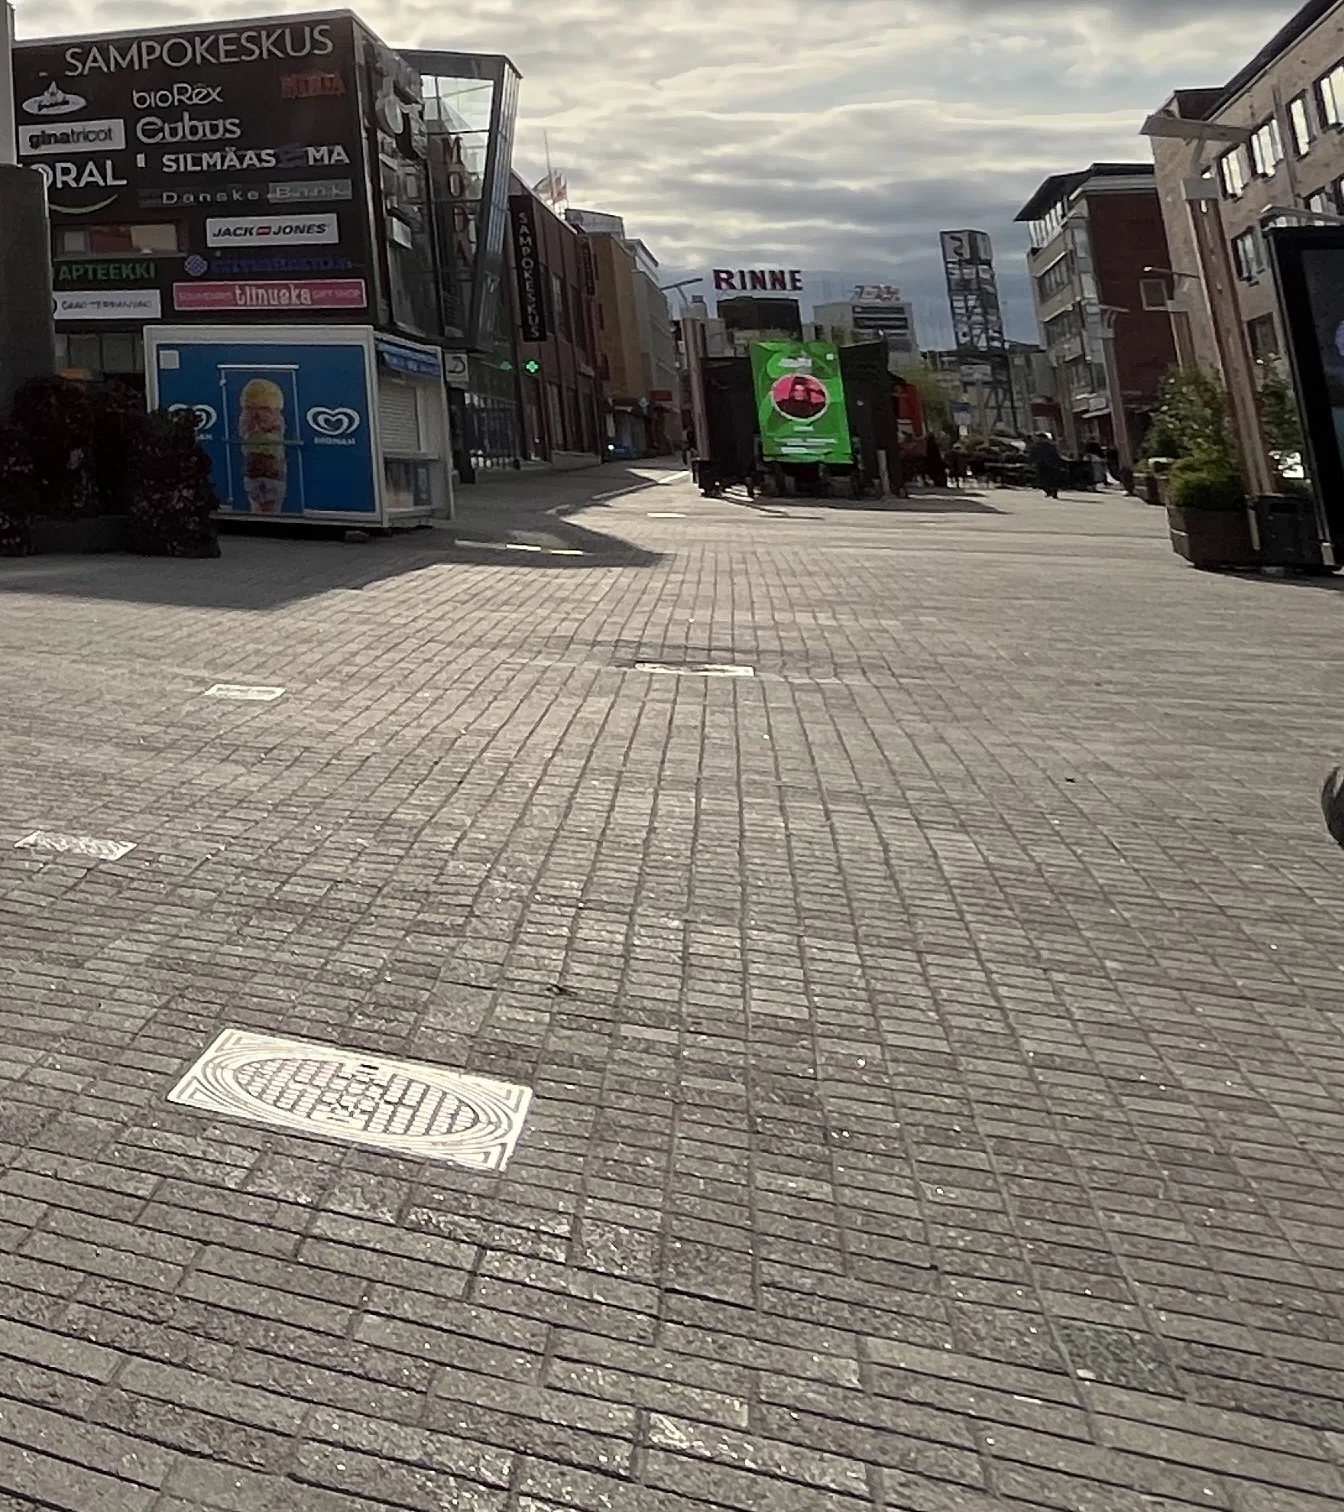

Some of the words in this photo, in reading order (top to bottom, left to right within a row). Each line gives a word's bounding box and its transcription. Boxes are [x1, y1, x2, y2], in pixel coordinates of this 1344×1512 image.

[64, 24, 335, 77] SAMPOKESKUS
[135, 111, 242, 144] Cubus
[161, 189, 260, 205] Danske
[275, 184, 344, 200] Bank
[212, 226, 257, 237] JACK
[272, 223, 327, 236] JONES
[57, 261, 156, 281] APTEEKKI
[517, 211, 541, 339] SAMPOKESKUS
[713, 268, 804, 291] RINNE
